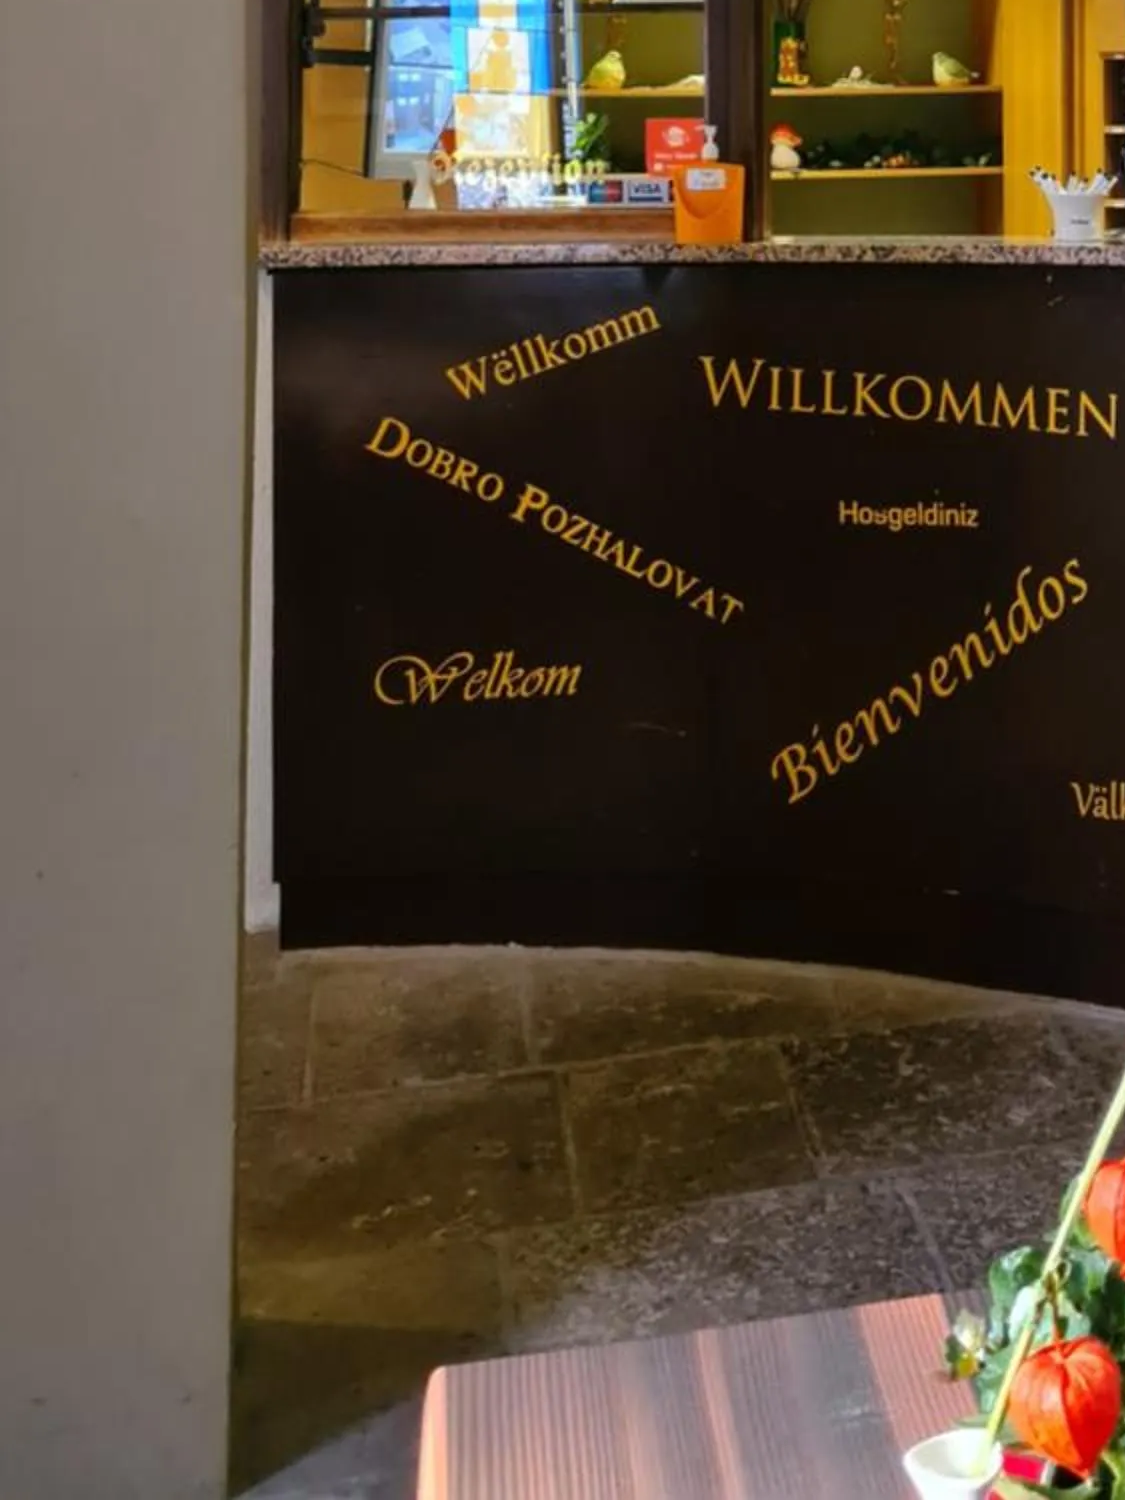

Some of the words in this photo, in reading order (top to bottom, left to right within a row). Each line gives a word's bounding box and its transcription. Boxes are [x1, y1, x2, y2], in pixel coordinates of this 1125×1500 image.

[443, 303, 661, 401] Wëllkomm
[699, 354, 1121, 440] WILLKOMMEN
[363, 415, 505, 503] DOBRO
[509, 480, 745, 627] POZHALOVAT
[373, 649, 583, 707] Welkom
[770, 556, 1091, 805] Bienvenidos
